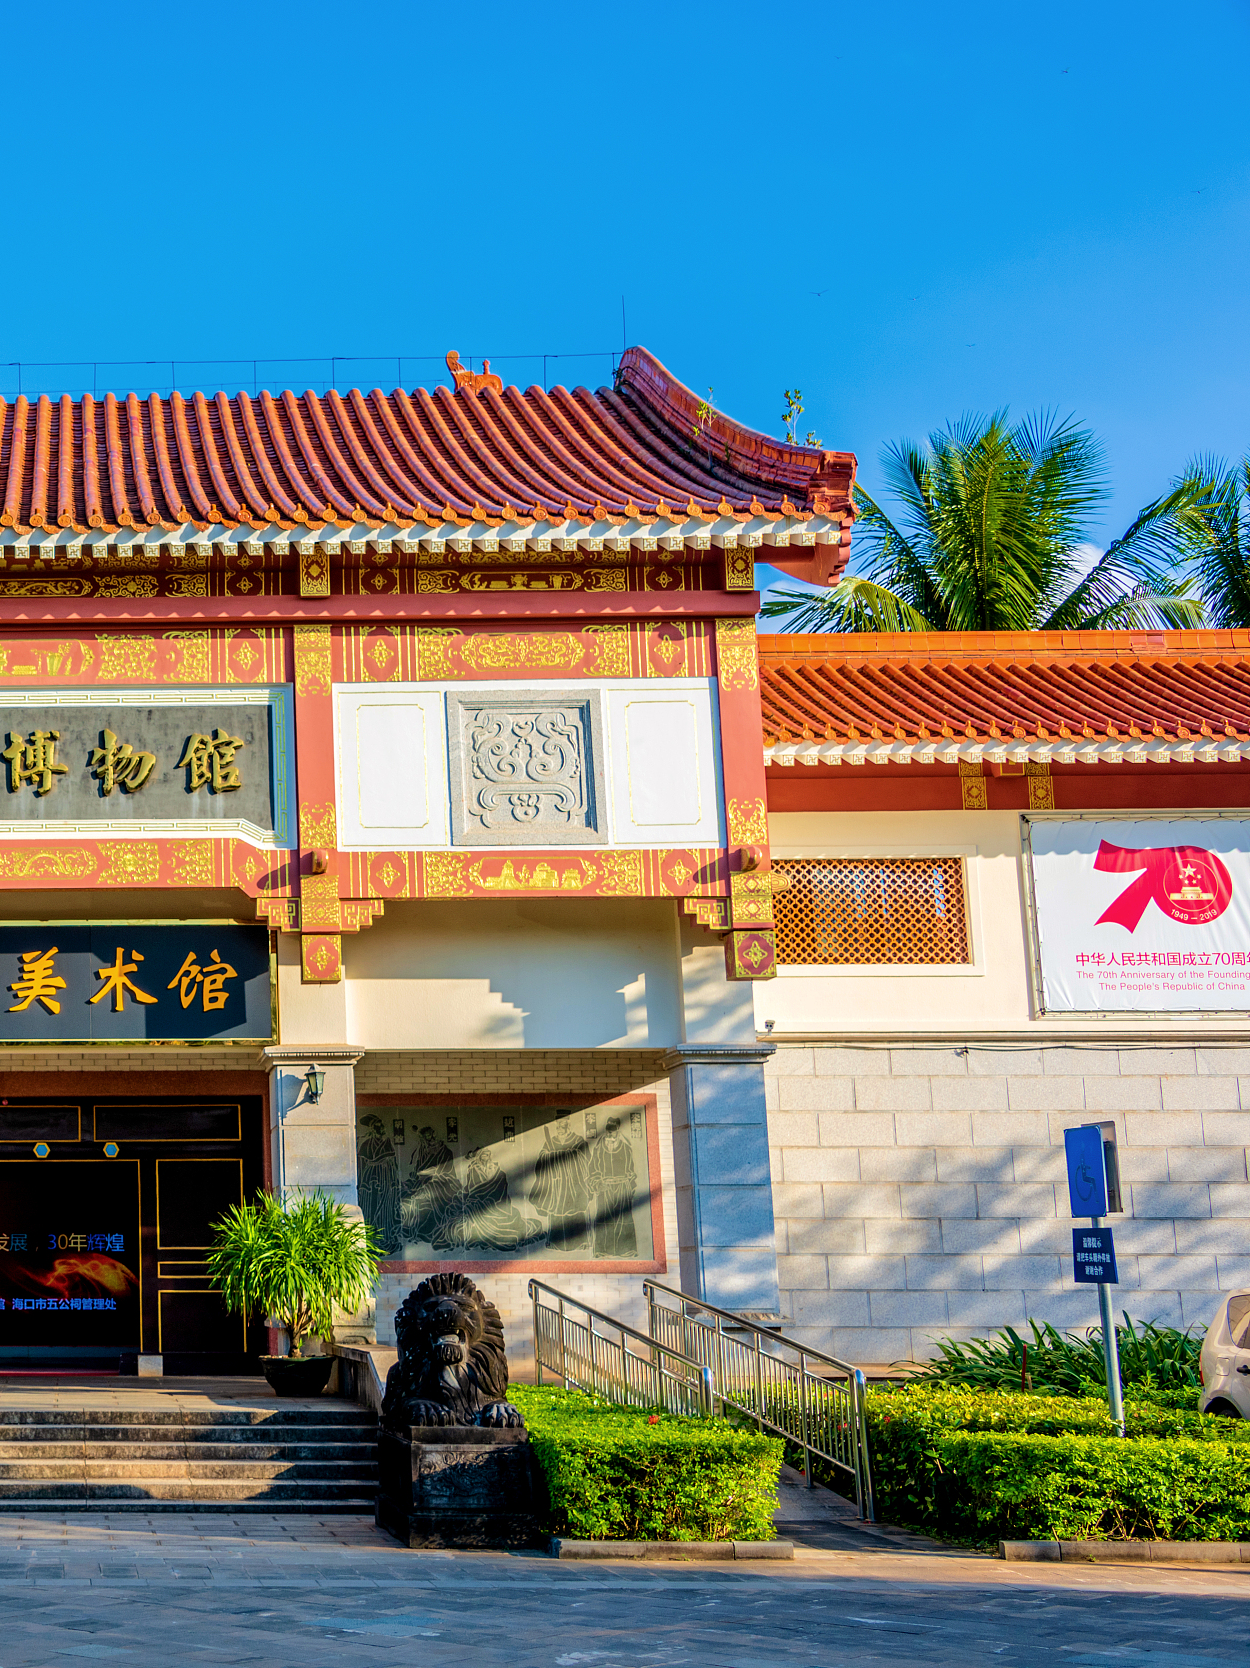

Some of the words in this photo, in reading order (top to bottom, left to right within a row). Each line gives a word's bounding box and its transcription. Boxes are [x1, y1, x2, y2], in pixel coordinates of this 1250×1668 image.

[1075, 951, 1250, 967] 中华人民共和国成立70周
[1076, 970, 1094, 979] The
[1097, 970, 1117, 979] 70th
[1120, 970, 1175, 981] Anniversary
[1178, 970, 1187, 979] of
[1190, 970, 1205, 979] the
[1207, 970, 1250, 981] Founding
[1099, 982, 1117, 991] The
[1120, 982, 1160, 992] People's
[1162, 982, 1204, 992] Republic
[1206, 982, 1215, 991] of
[1217, 982, 1246, 991] China
[12, 1298, 117, 1310] 海口市五公祠管理处
